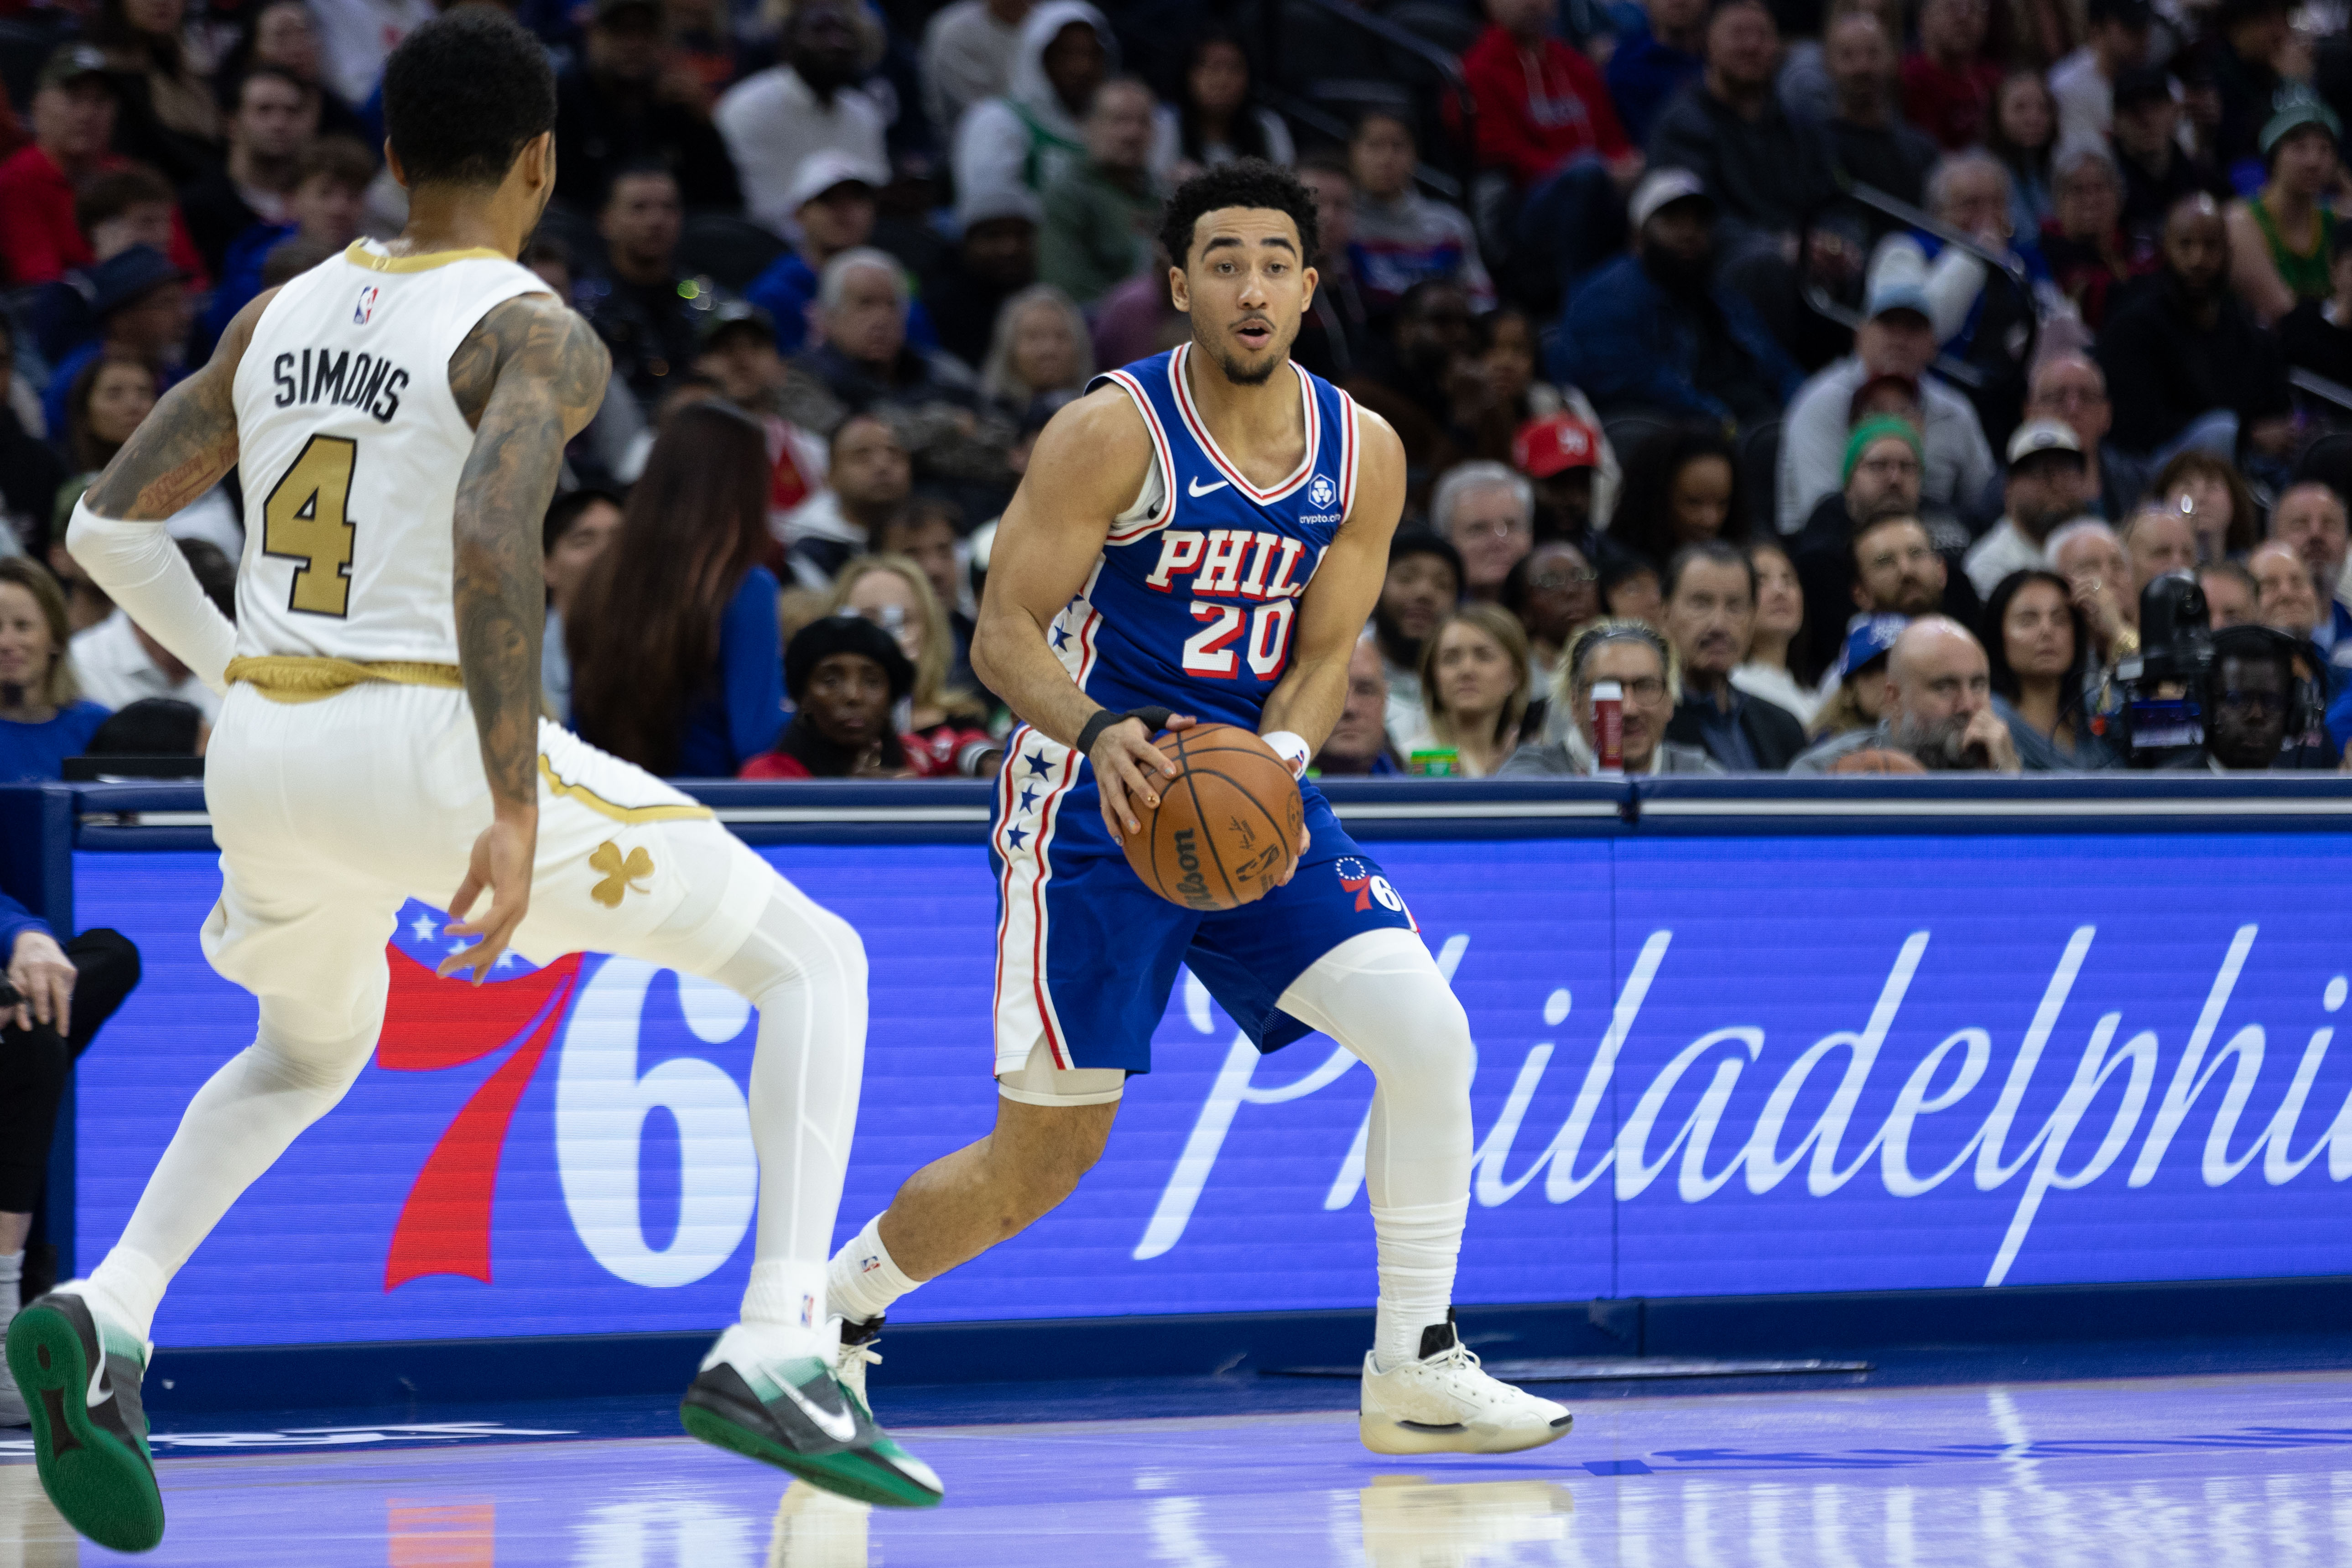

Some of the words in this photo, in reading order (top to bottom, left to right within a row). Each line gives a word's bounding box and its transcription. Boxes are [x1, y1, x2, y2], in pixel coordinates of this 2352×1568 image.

[274, 348, 409, 423] SIMONS
[262, 433, 357, 620] 4
[1299, 513, 1341, 524] crypto.cm
[1145, 530, 1329, 601] PHIL
[1182, 597, 1295, 681] 20
[1339, 875, 1402, 912] 76
[376, 940, 759, 1295] 76
[1132, 922, 2352, 1287] Piladelphi
